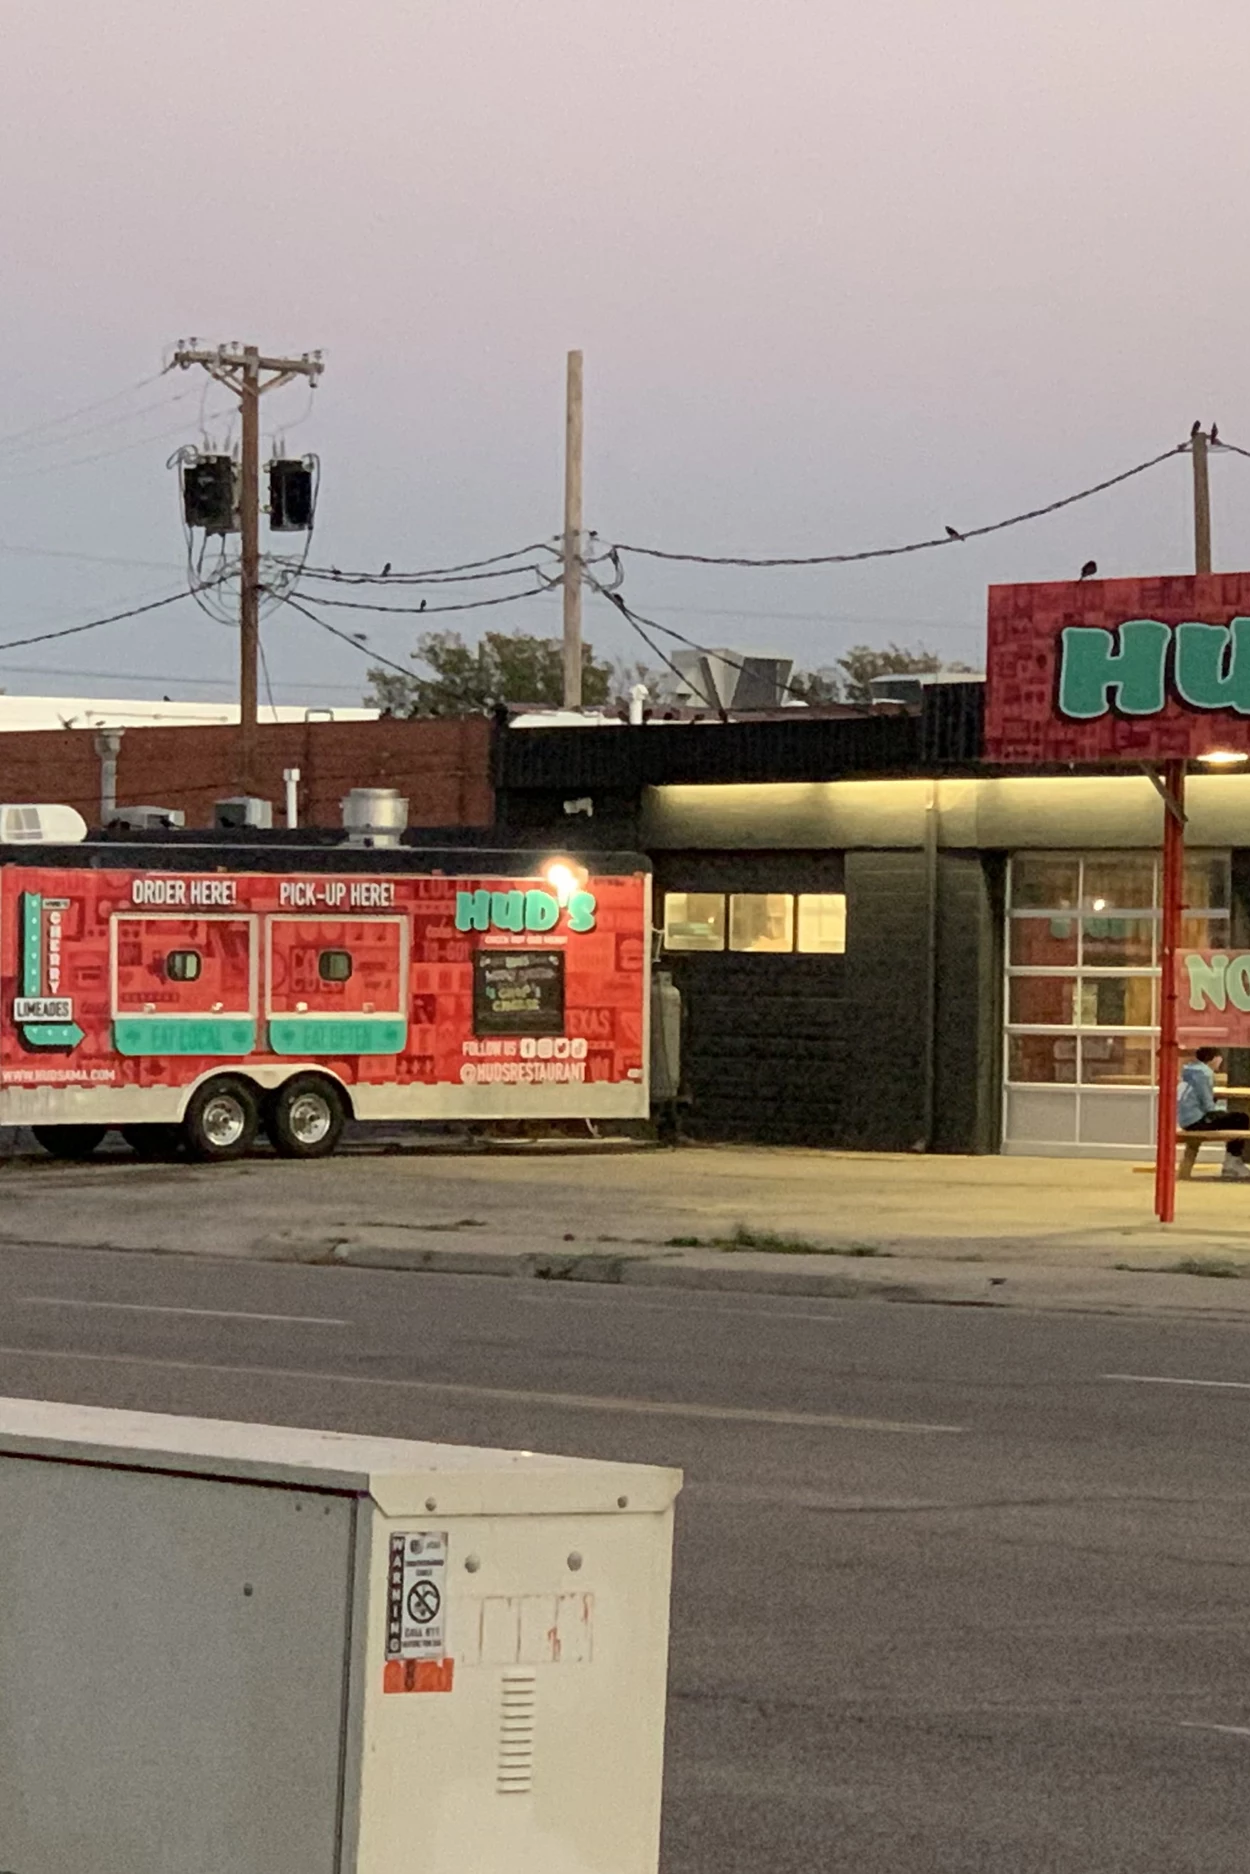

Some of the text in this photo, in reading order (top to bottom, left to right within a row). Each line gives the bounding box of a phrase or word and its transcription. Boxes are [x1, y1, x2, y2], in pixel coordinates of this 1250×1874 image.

[132, 880, 237, 905] ORDER HERE!
[280, 882, 395, 907] PICK-UP HERE!
[48, 911, 61, 994] CHERRY
[16, 1002, 69, 1018] LIMEADES
[462, 1041, 517, 1056] FOLLOW US
[460, 1062, 586, 1082] @HUDSRESTAURANT
[390, 1538, 403, 1652] WARNING
